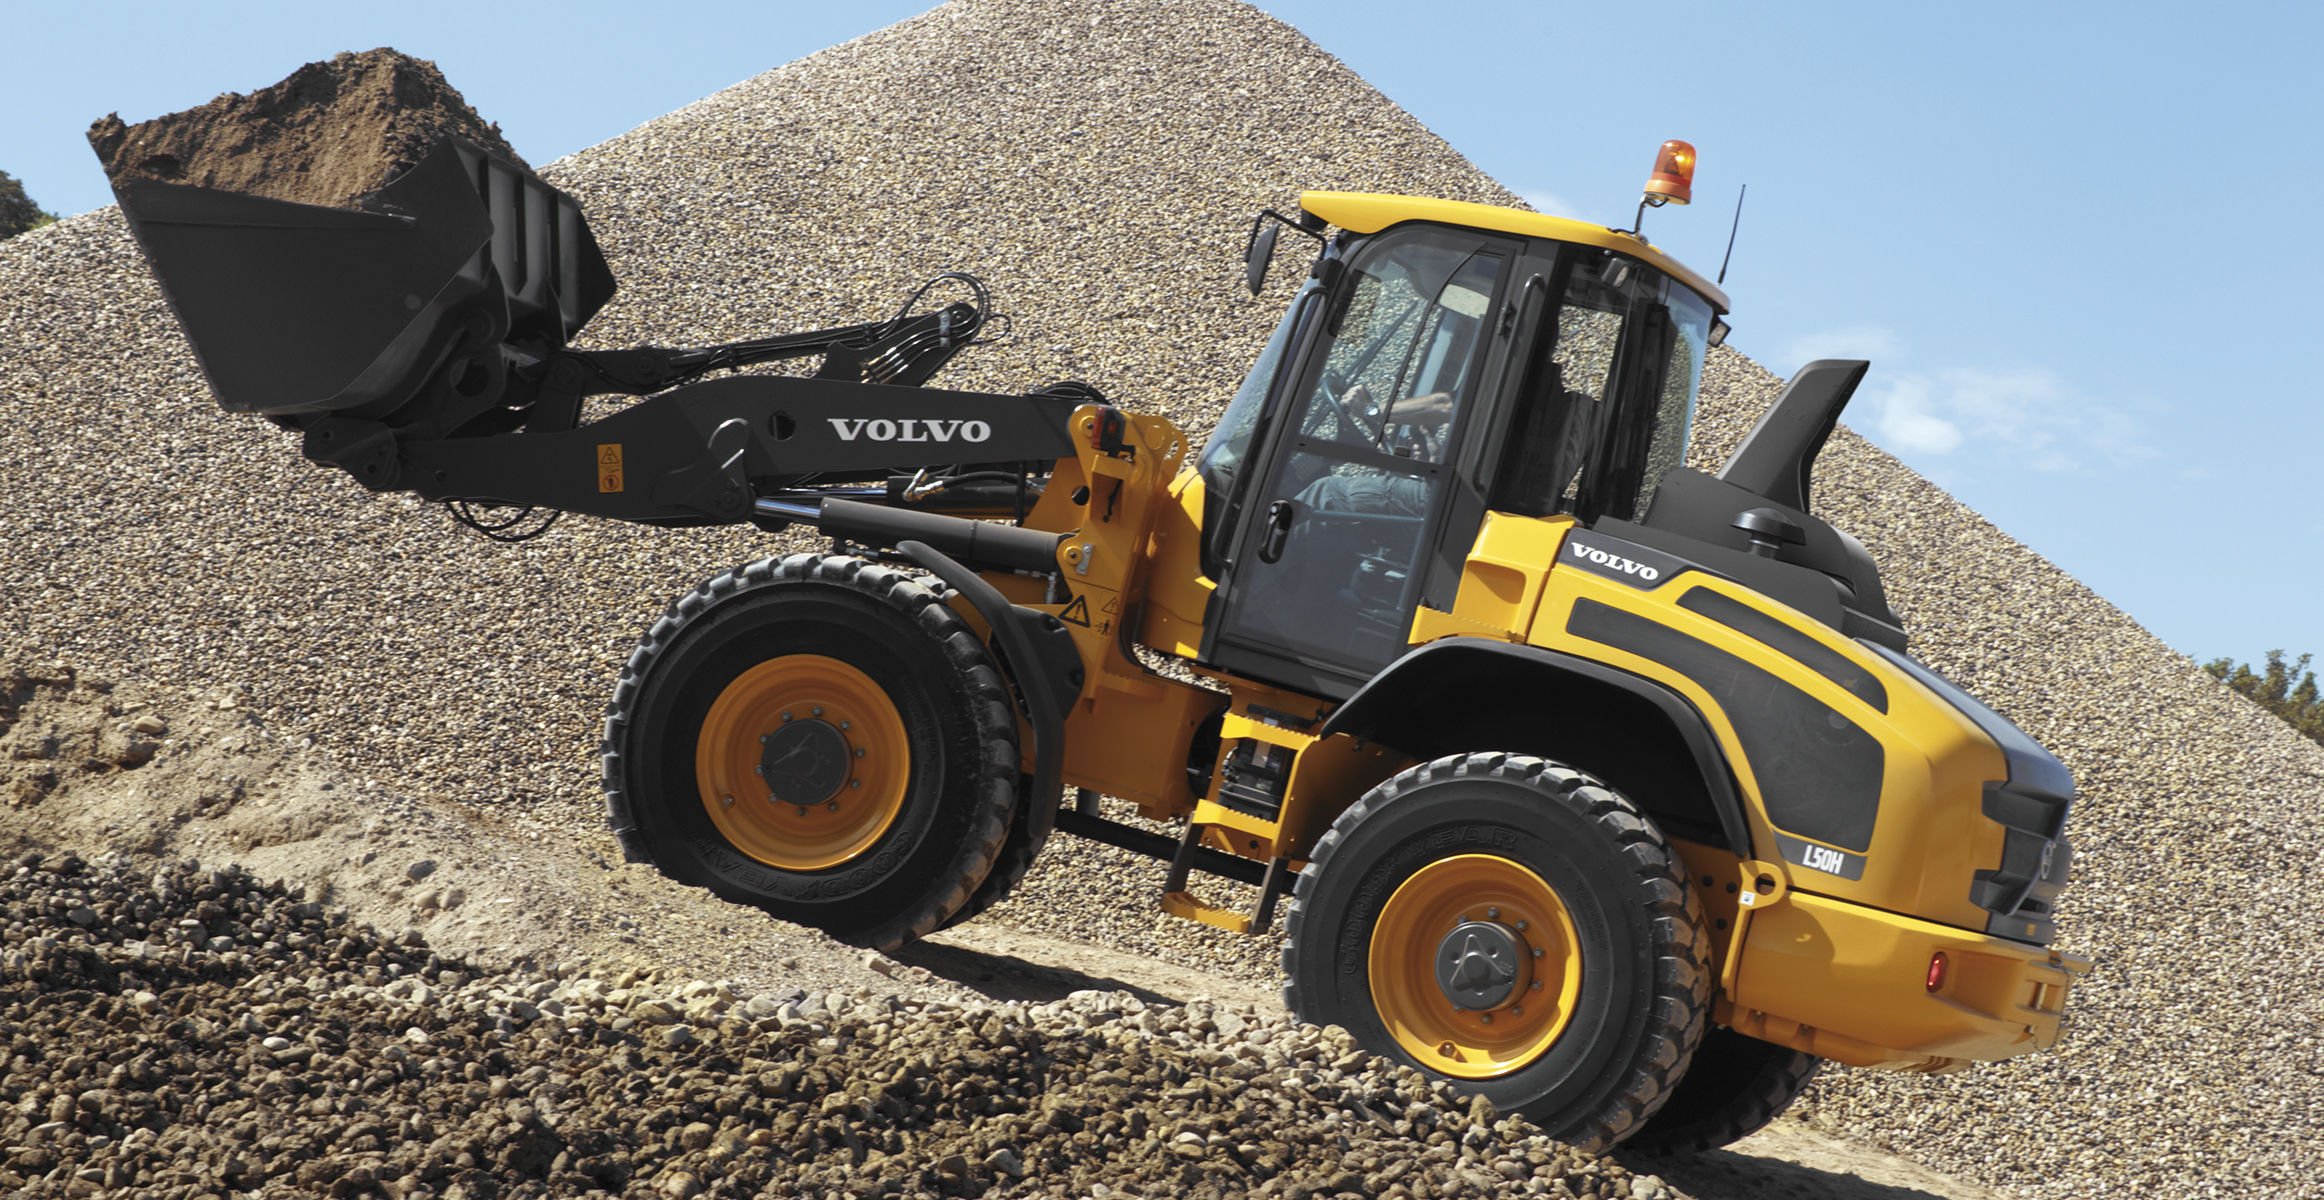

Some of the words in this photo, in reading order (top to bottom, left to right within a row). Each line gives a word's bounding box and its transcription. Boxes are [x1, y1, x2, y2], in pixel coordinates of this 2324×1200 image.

[827, 418, 991, 443] VOLVO
[1571, 542, 1658, 580] VOLVO
[1802, 844, 1844, 874] L50H
